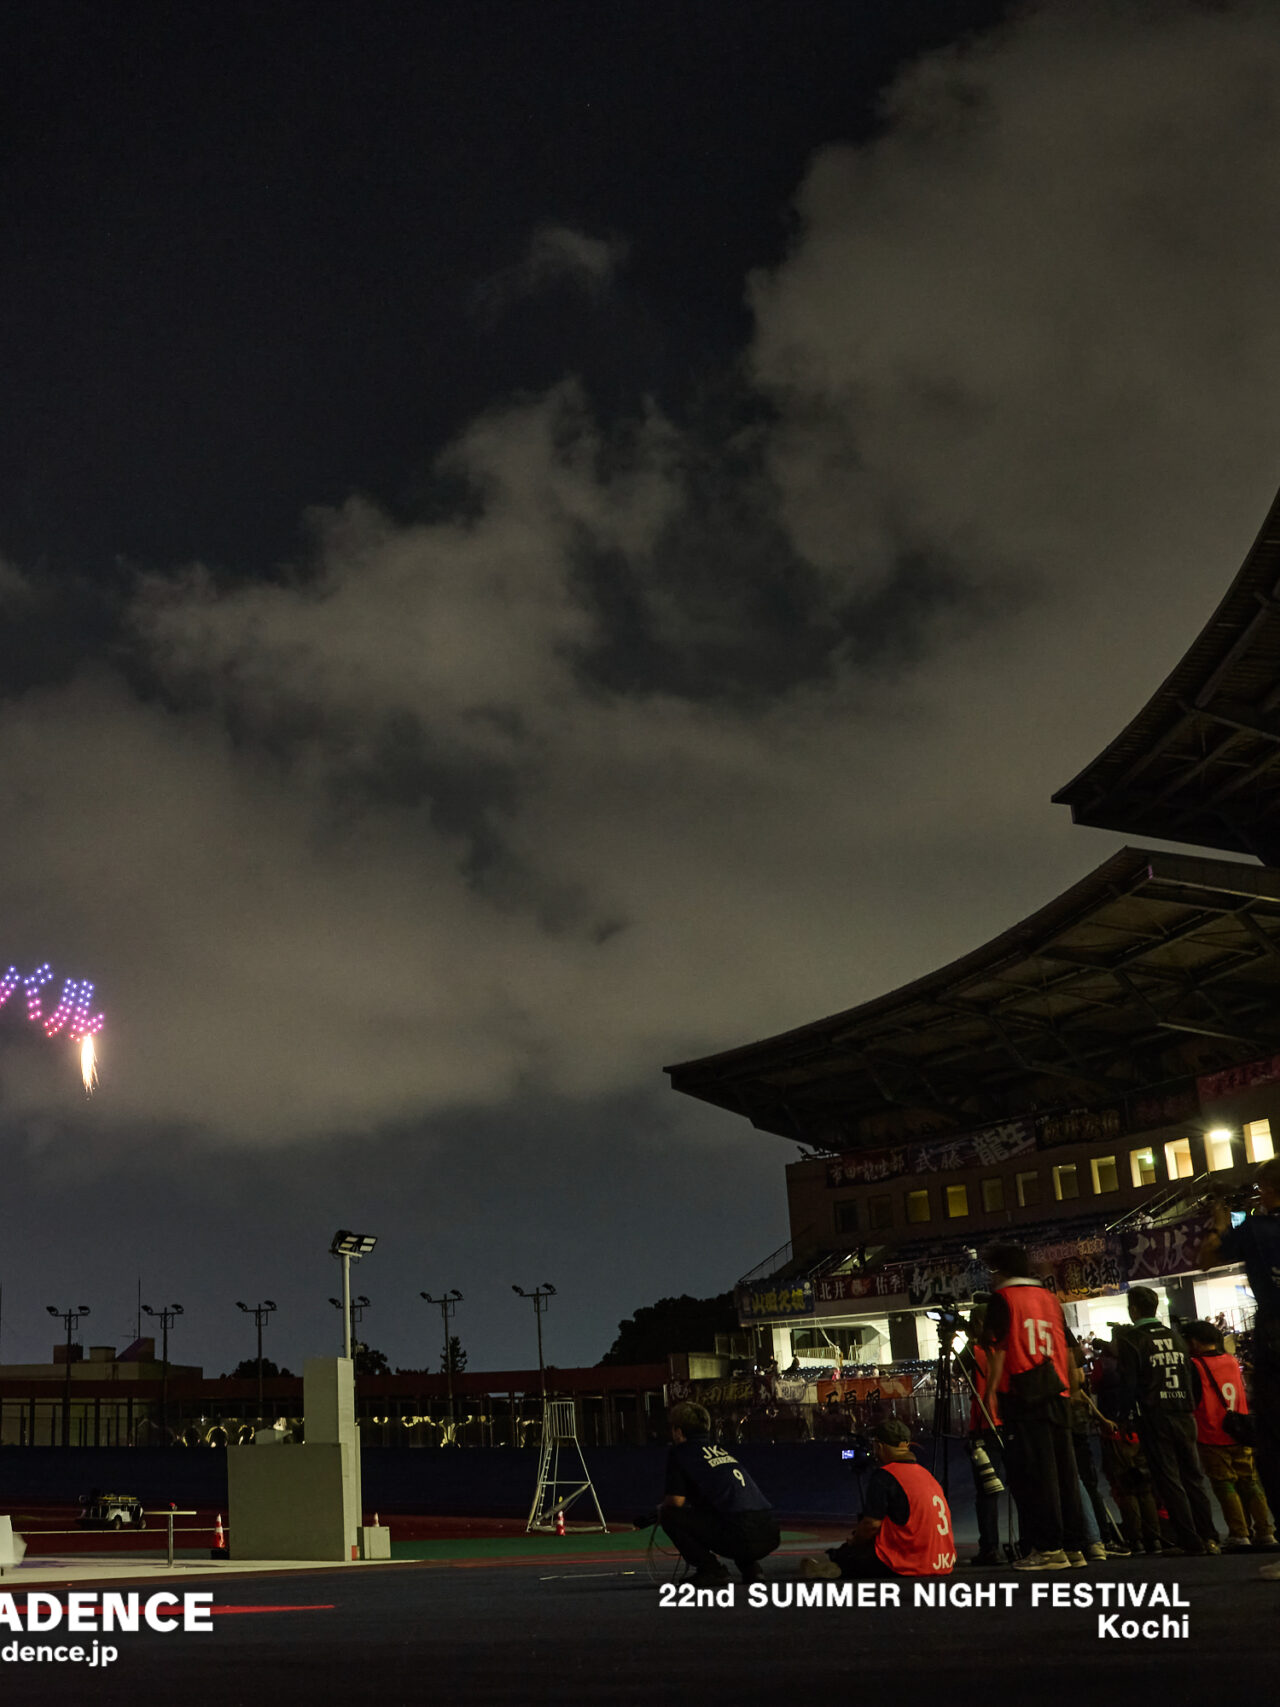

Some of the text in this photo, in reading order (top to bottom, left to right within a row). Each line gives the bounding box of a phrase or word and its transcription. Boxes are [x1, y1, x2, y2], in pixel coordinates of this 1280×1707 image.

[1023, 1317, 1054, 1356] 15
[1152, 1337, 1174, 1352] TV
[1164, 1365, 1180, 1390] 5
[1221, 1382, 1236, 1410] 9
[732, 1468, 747, 1488] 9
[932, 1494, 950, 1537] 3
